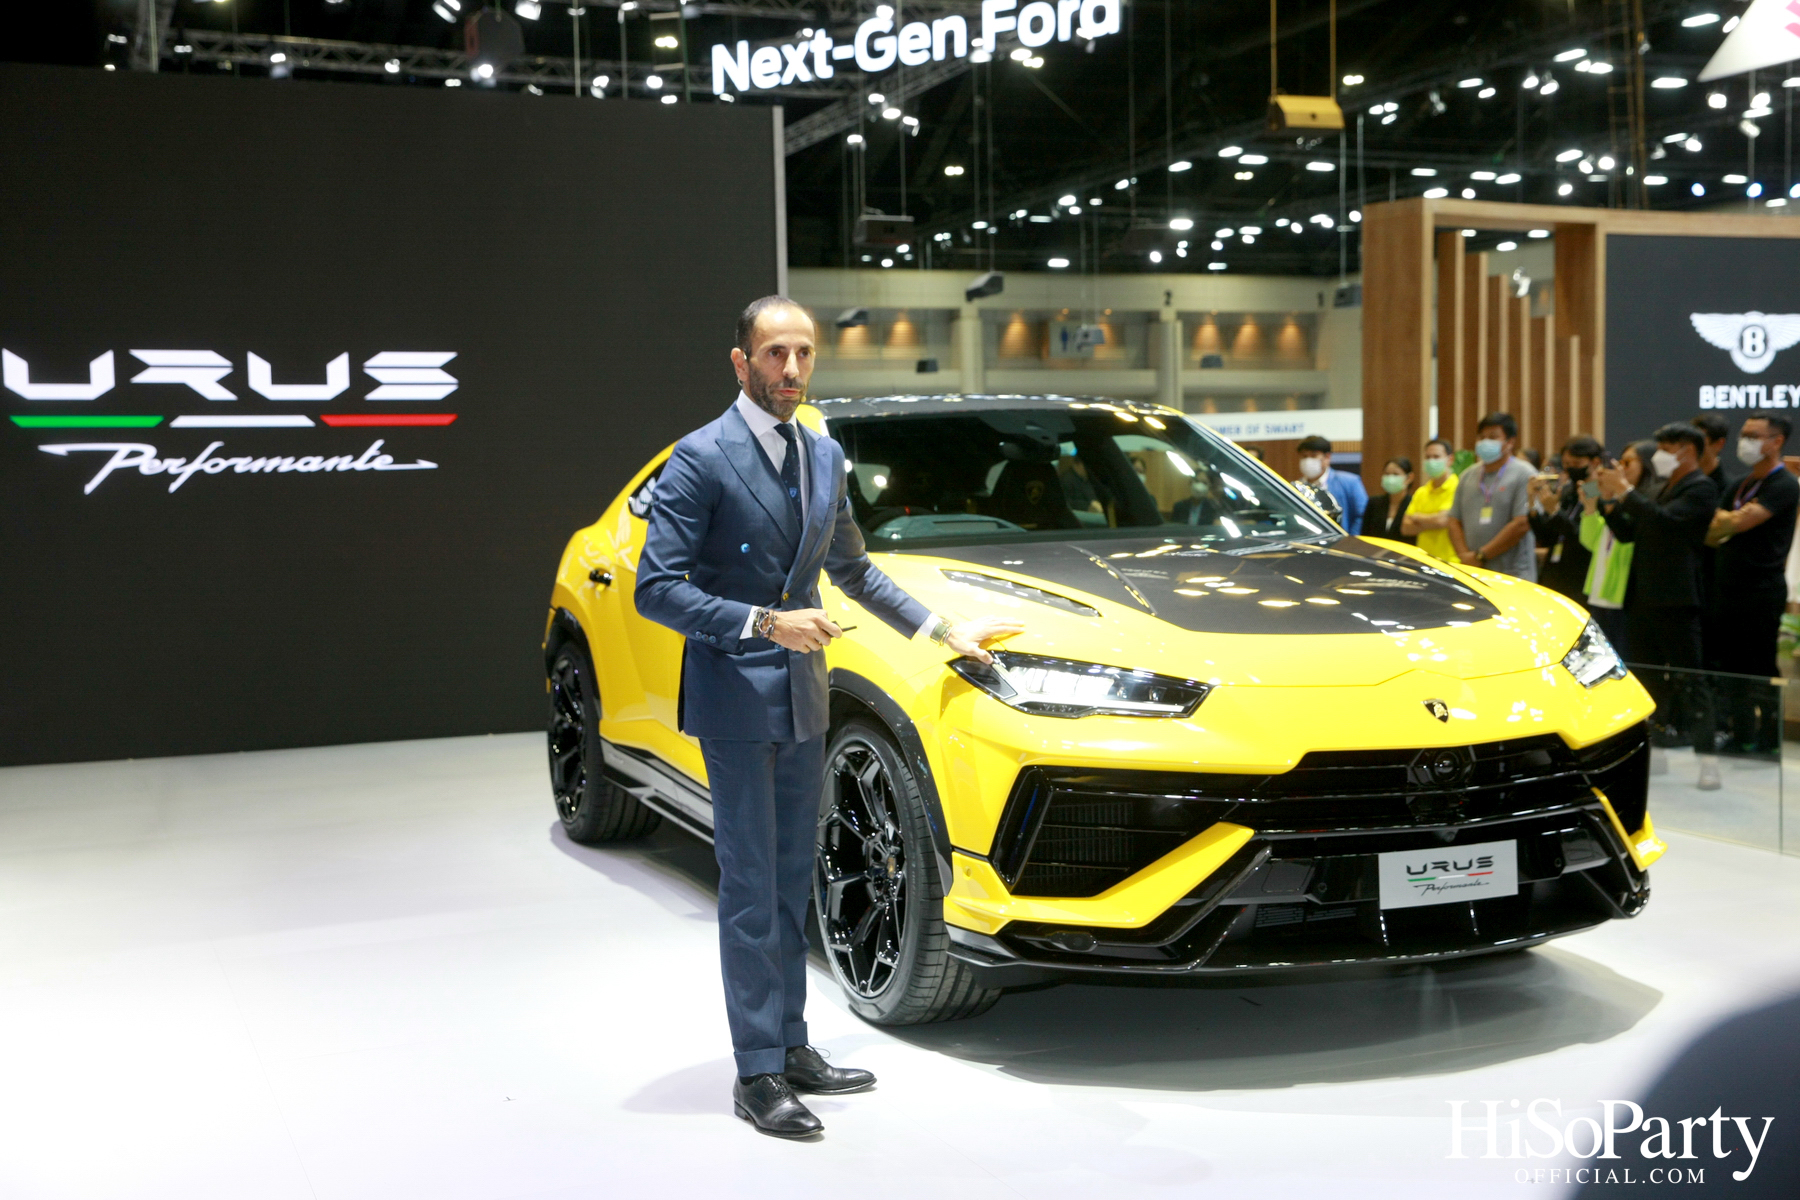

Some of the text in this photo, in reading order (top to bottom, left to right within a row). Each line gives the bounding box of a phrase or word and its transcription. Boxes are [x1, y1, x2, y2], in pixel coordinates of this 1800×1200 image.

[711, 0, 1121, 95] Next-Gen Ford
[2, 348, 459, 400] URUS
[1699, 385, 1800, 409] BENTLEY
[1264, 422, 1305, 434] SMART
[38, 439, 438, 495] Performante
[1406, 855, 1494, 876] URUS
[1413, 878, 1490, 896] Performante
